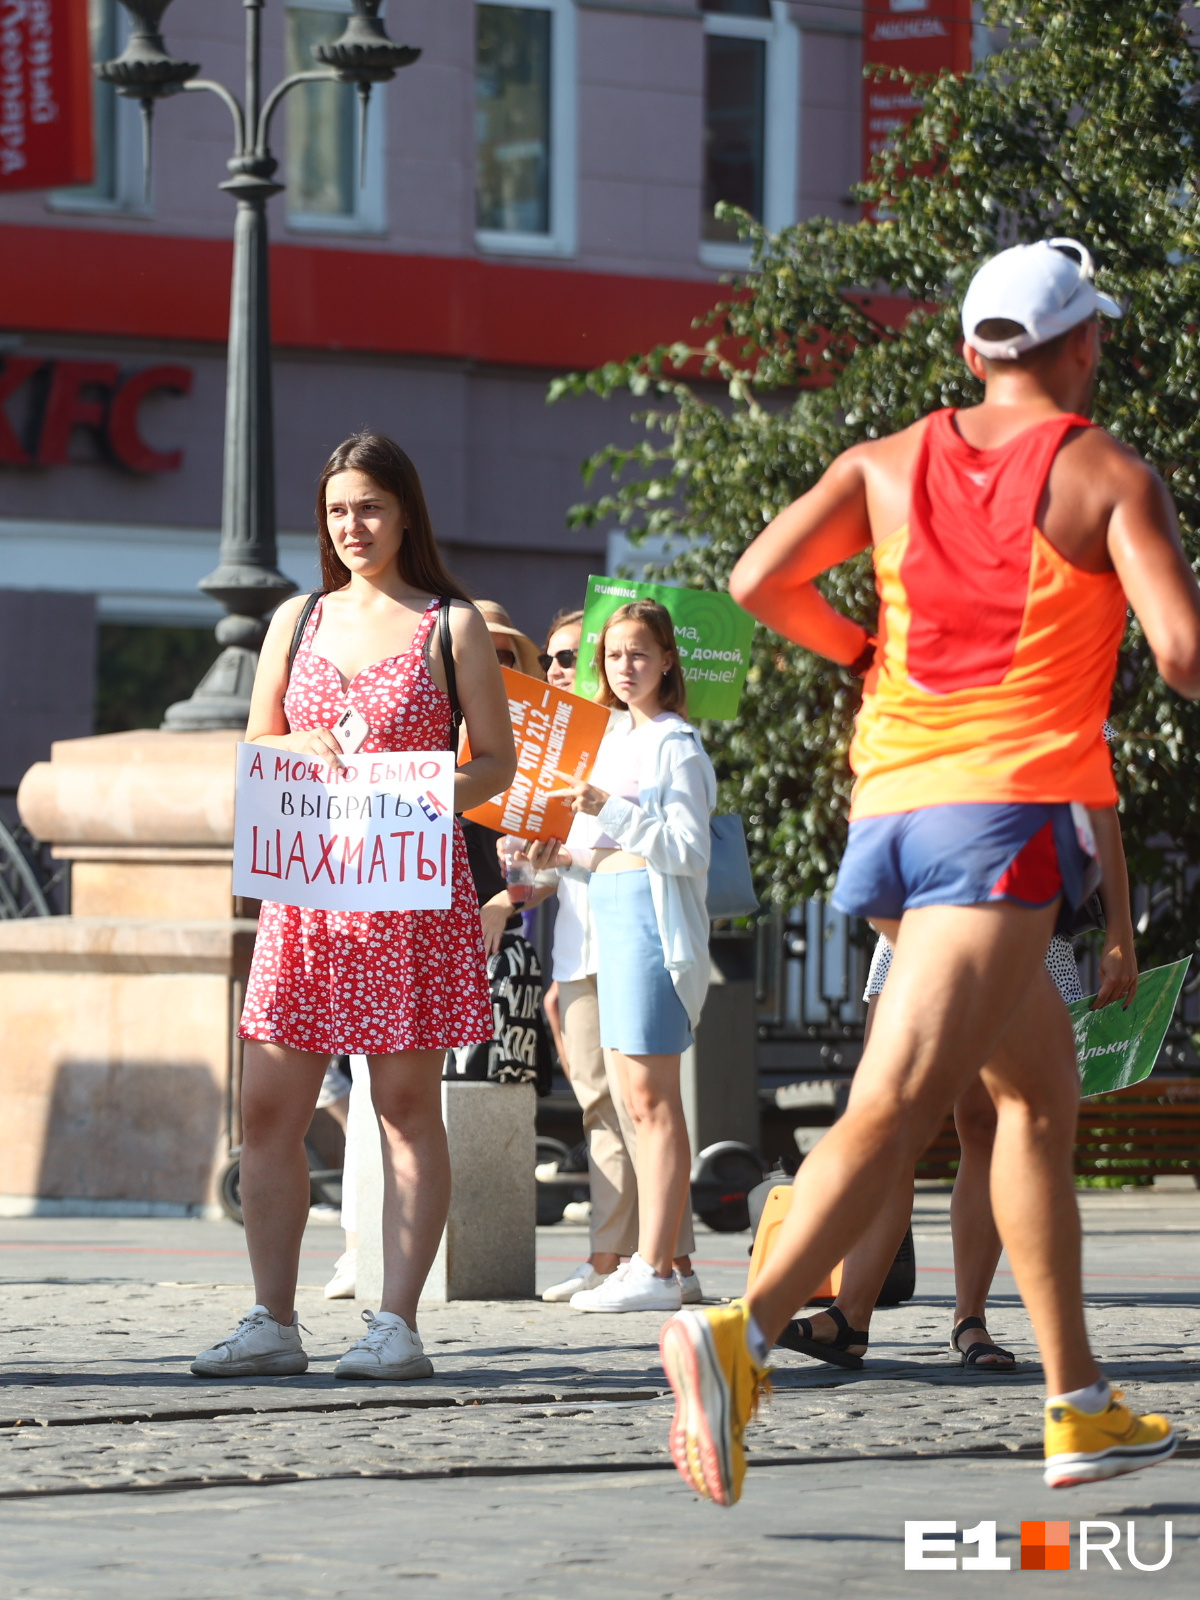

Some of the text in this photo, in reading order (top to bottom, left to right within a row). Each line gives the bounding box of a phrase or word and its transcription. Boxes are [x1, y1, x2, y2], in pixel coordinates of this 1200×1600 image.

[594, 583, 638, 600] RUNNING
[690, 648, 745, 666] домой,
[525, 708, 552, 742] 21,2
[249, 752, 264, 780] А
[368, 760, 441, 785] БЫЛО
[517, 740, 543, 772] ЧТО
[525, 700, 574, 833] ЭТО УЖЕ СУМАСШЕСТВИЕ
[281, 791, 413, 820] ВЫБРАТЬ
[500, 770, 534, 833] ПОТОМУ
[250, 825, 447, 887] ШАХМАТЫ
